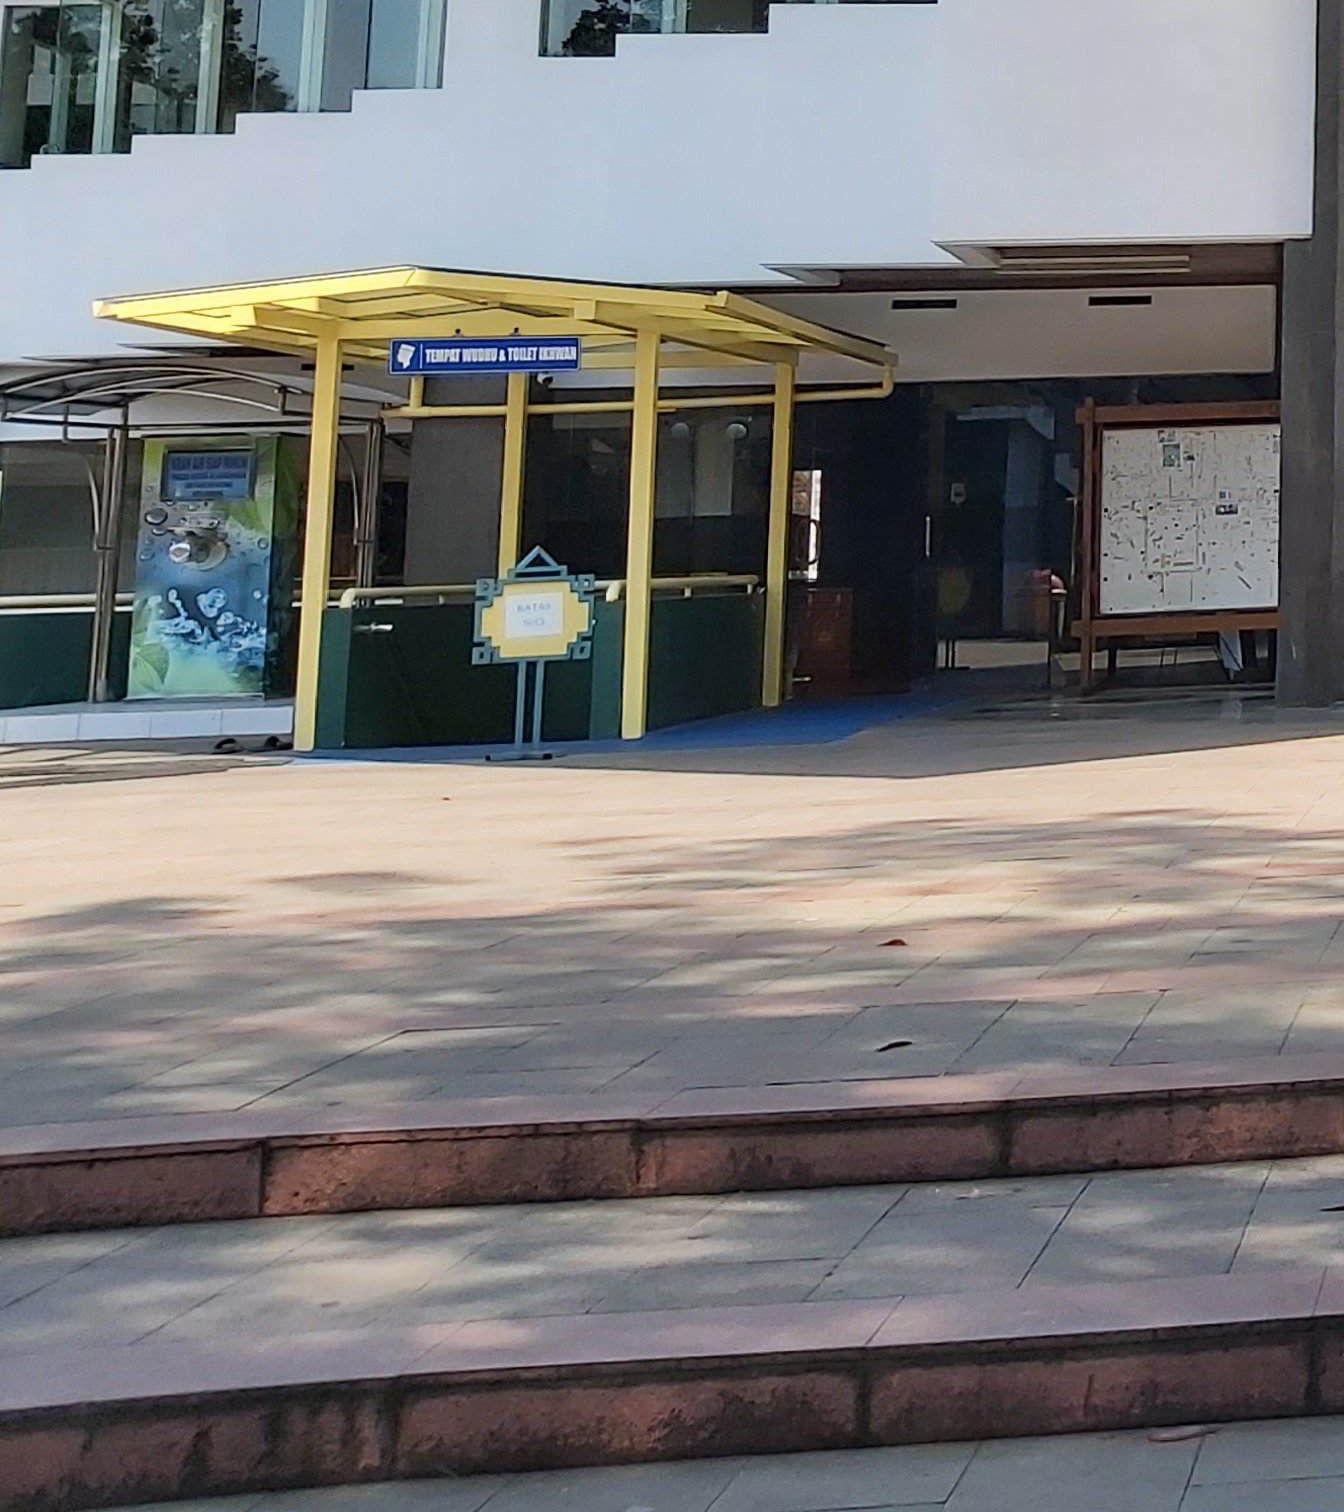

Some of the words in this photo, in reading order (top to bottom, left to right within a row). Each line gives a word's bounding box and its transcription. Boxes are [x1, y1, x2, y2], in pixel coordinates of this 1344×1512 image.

[424, 348, 461, 363] TEMPAT
[462, 347, 499, 363] WUDHU
[499, 348, 506, 362] &
[507, 346, 538, 361] TOILET
